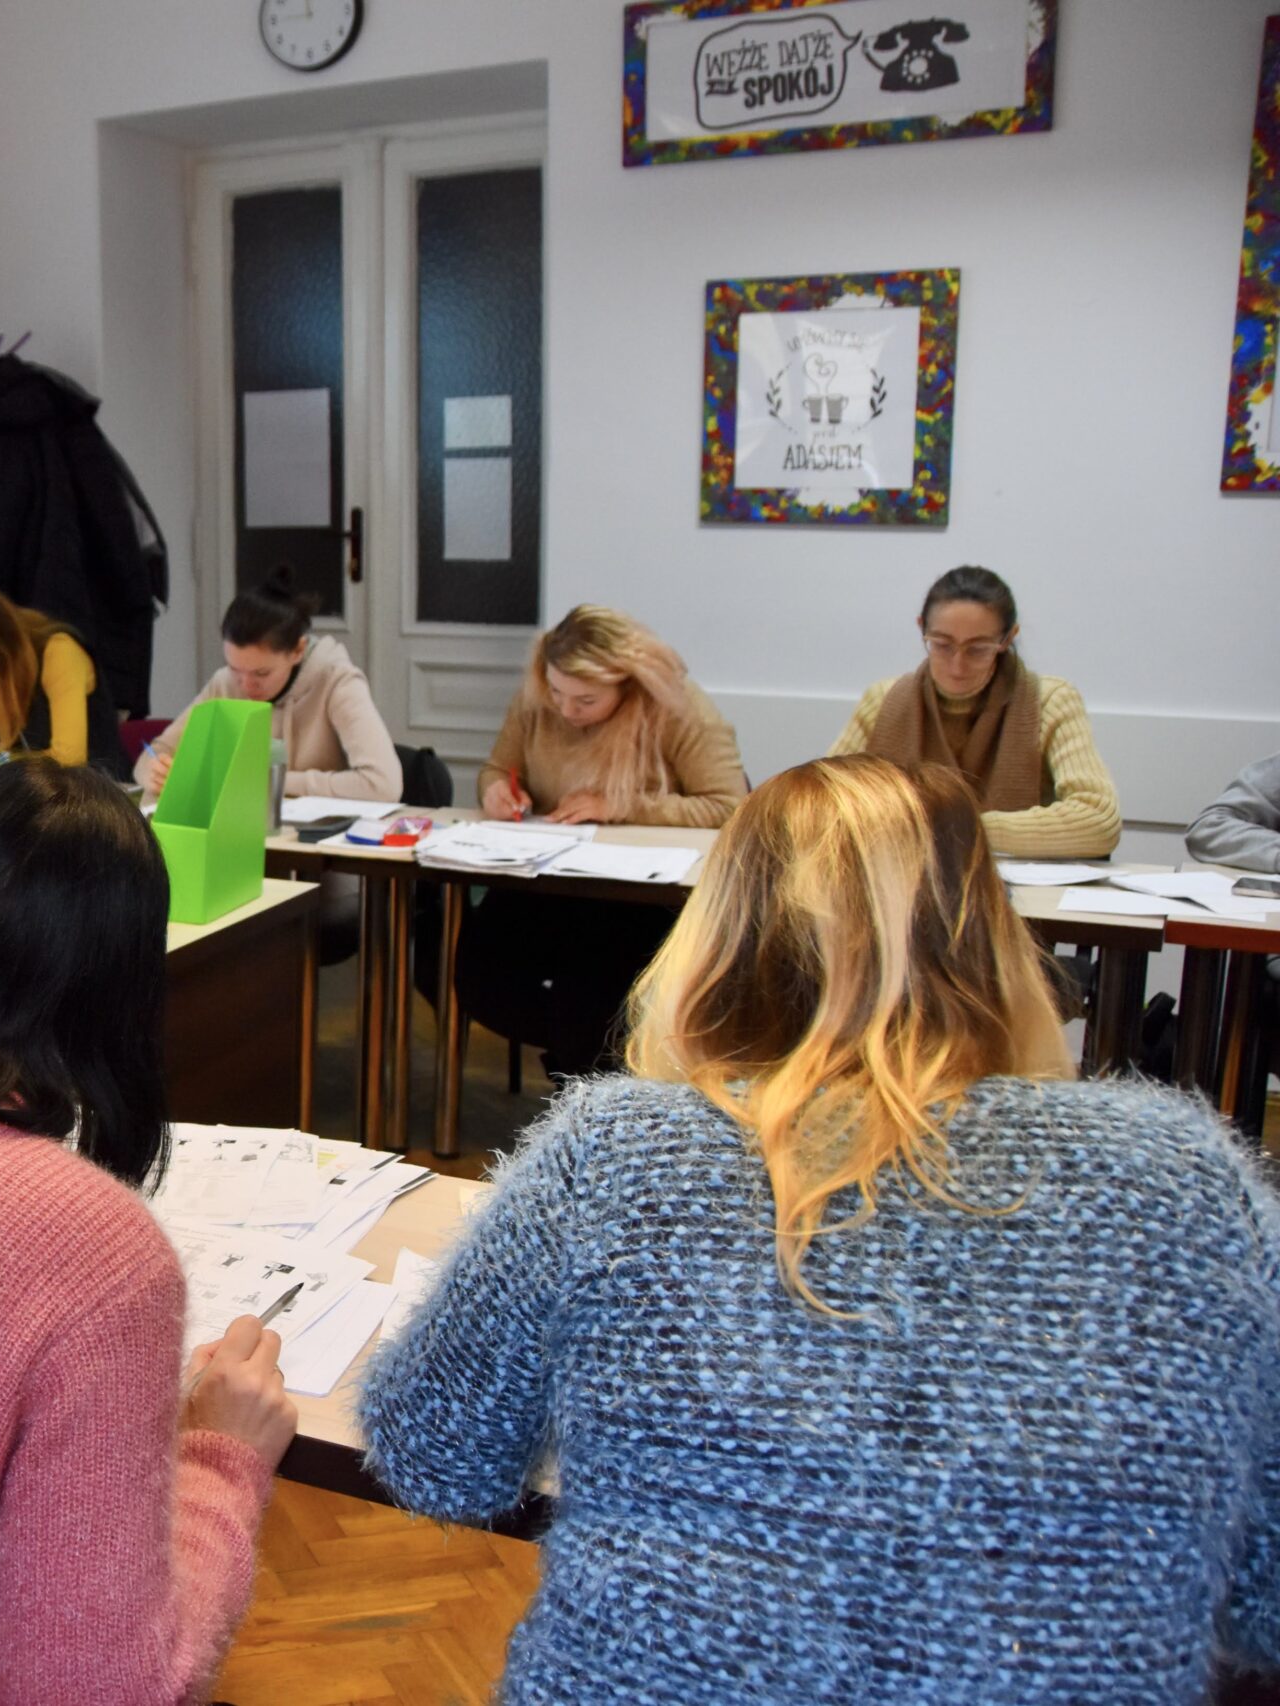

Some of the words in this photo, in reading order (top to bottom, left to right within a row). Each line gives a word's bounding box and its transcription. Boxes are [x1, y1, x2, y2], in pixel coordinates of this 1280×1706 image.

[779, 29, 835, 67] DAJŻE
[743, 61, 835, 108] SPOKÓJ
[783, 443, 864, 471] ADASIEM
